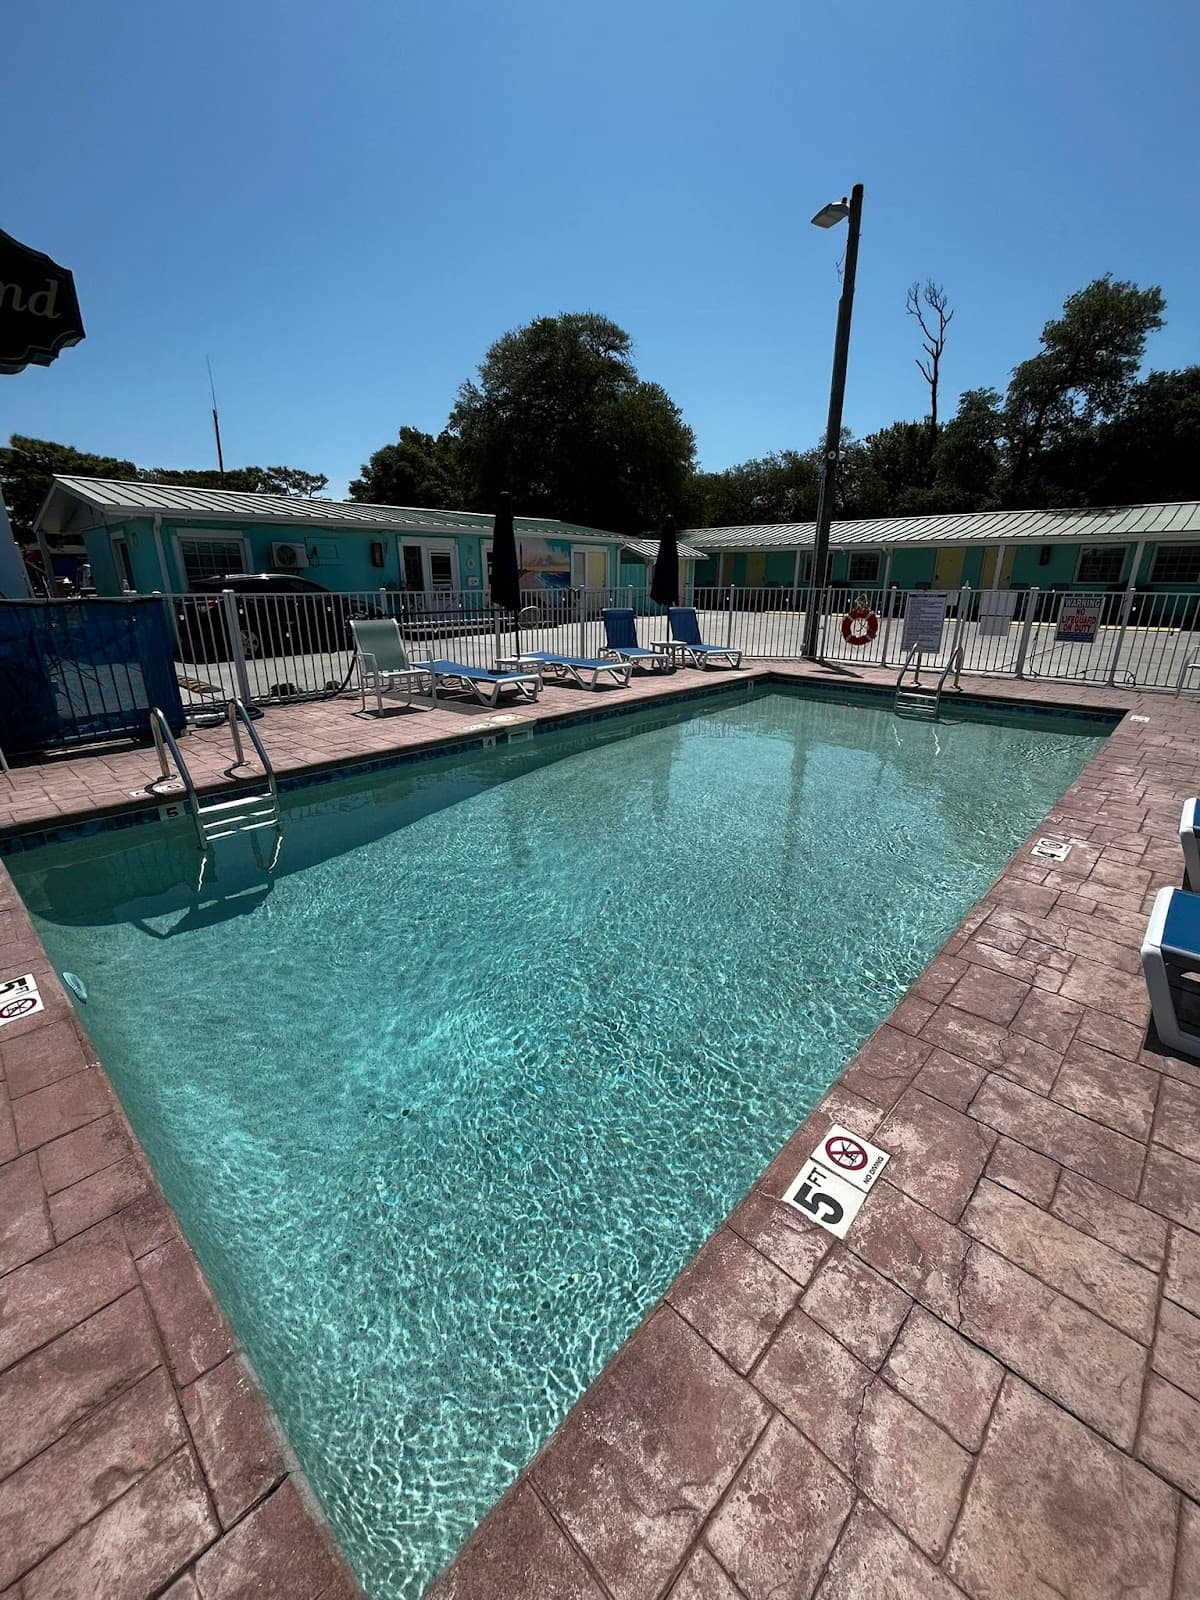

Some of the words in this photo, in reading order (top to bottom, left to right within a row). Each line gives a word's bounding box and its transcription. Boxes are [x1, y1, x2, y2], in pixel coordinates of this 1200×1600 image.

[1065, 599, 1101, 608] WARNING
[1076, 608, 1086, 616] NO
[1061, 616, 1097, 625] LIFEGUARD
[1075, 624, 1091, 632] DUTY
[166, 807, 179, 818] 5
[863, 1174, 873, 1185] NO
[870, 1156, 884, 1175] DIVING
[806, 1166, 828, 1188] FT
[792, 1182, 844, 1225] 5
